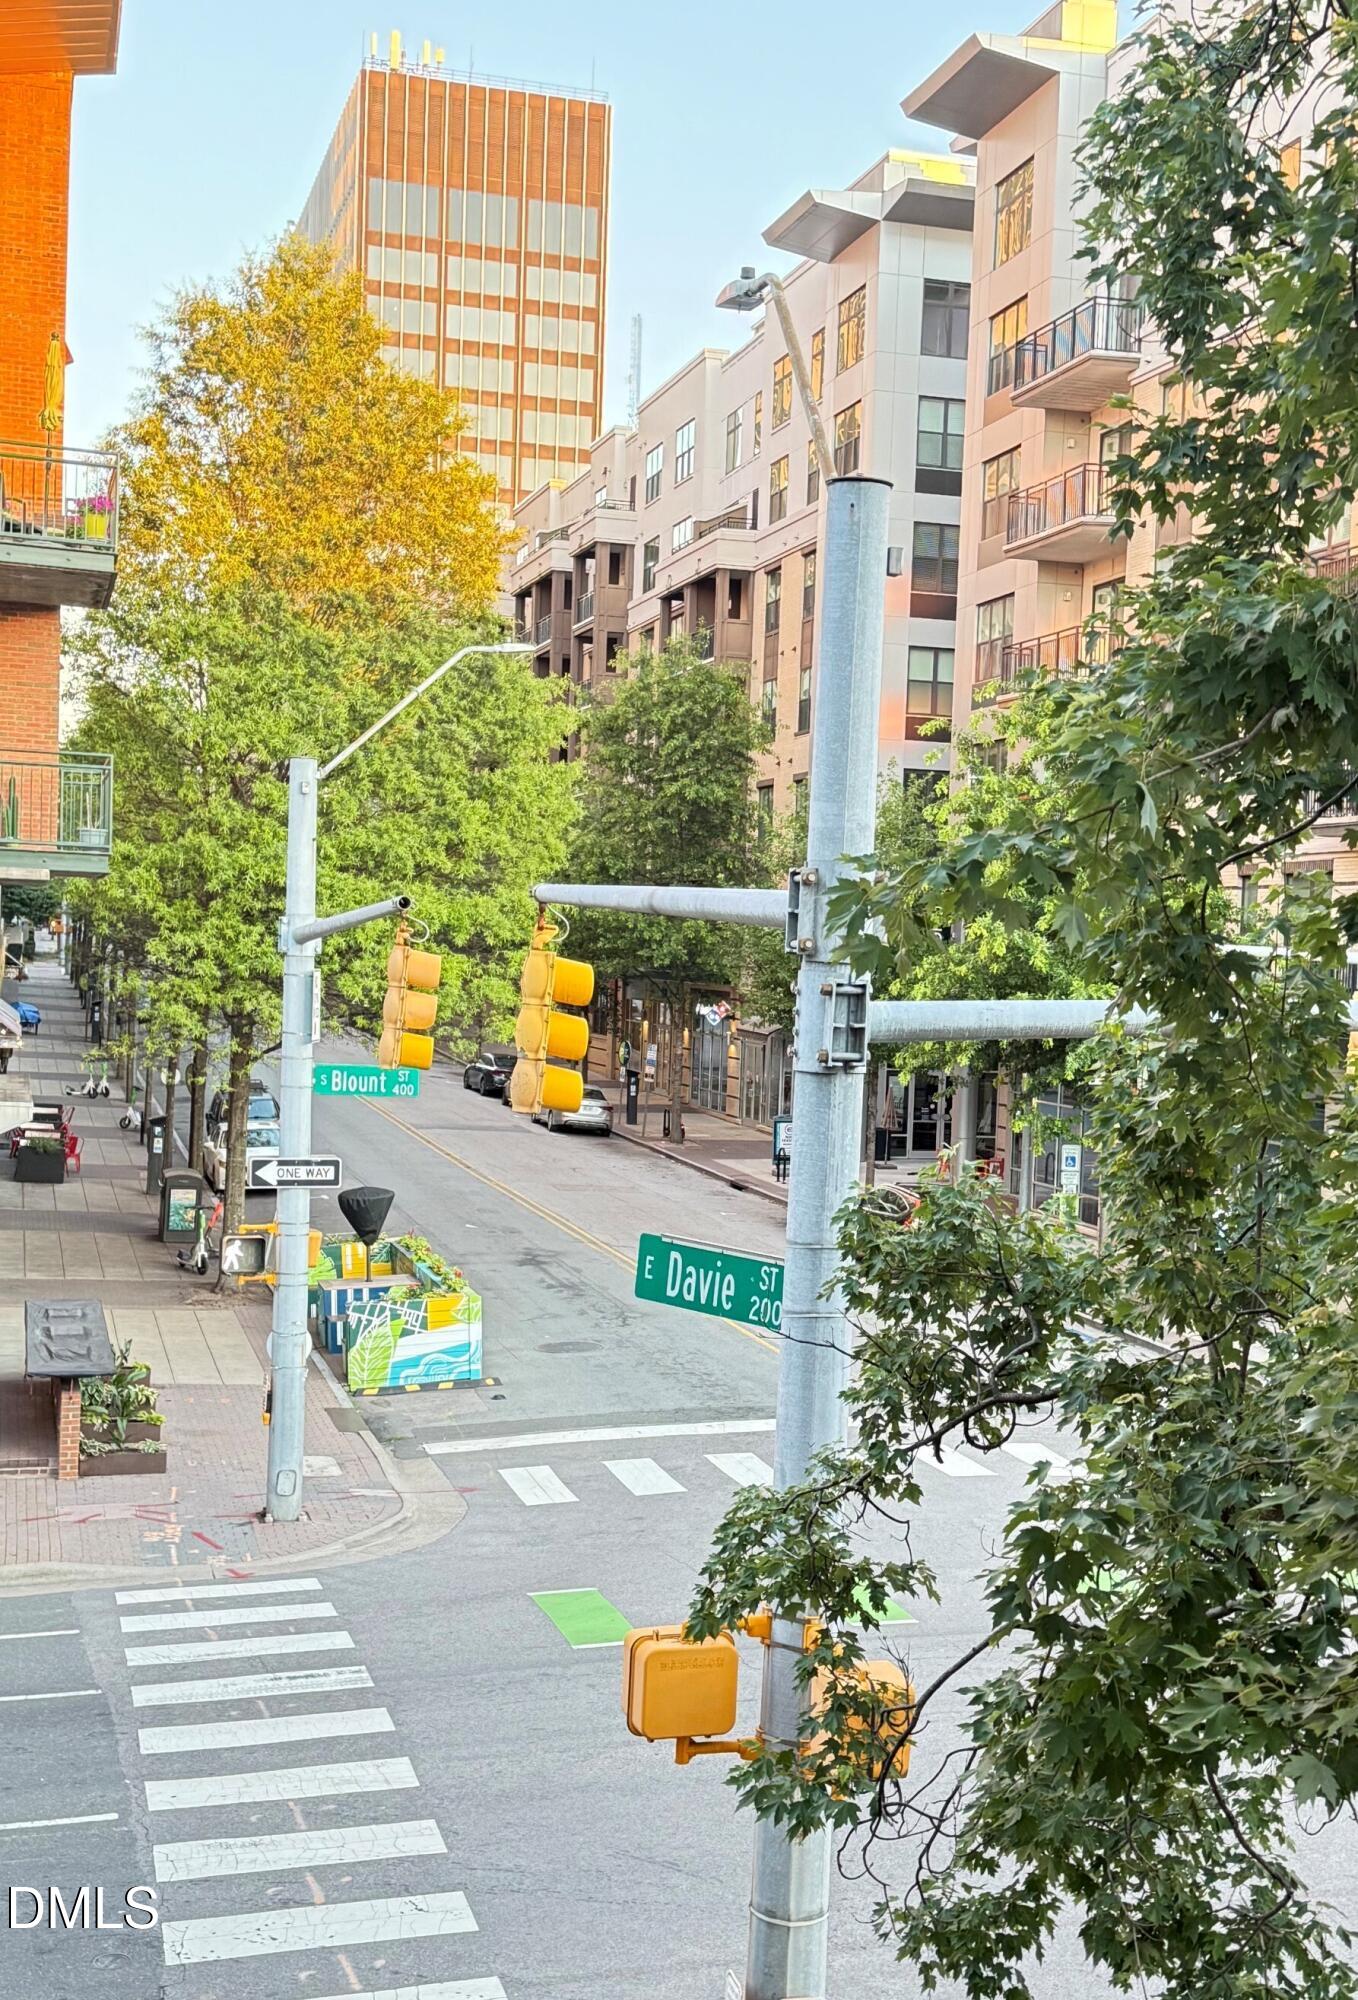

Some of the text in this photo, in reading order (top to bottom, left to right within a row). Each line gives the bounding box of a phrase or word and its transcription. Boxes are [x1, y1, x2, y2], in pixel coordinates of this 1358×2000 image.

[320, 1069, 411, 1093] S Blount ST
[391, 1083, 415, 1096] 400
[277, 1167, 331, 1179] ONE WAY
[644, 1250, 780, 1311] E Davie ST
[748, 1295, 782, 1327] 200
